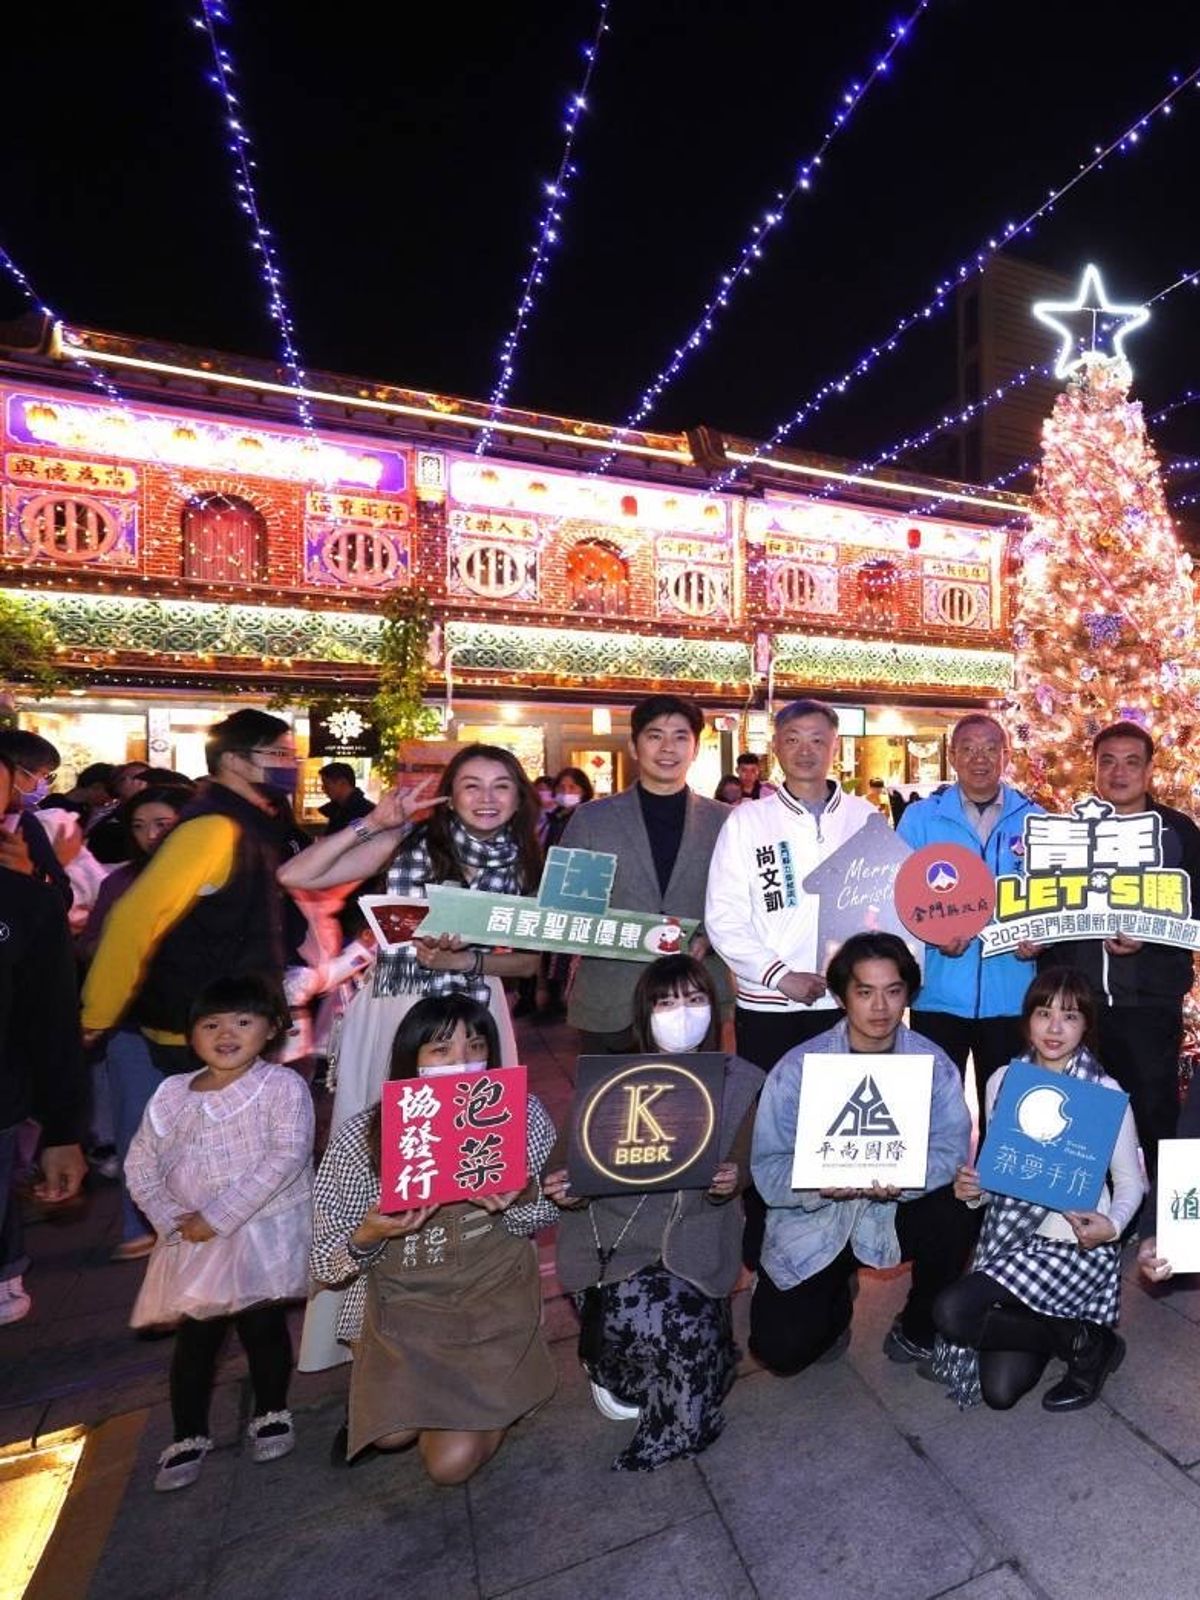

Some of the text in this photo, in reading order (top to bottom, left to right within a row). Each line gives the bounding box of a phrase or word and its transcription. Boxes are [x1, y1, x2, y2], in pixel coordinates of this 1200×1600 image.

[1028, 817, 1156, 870] 青年
[756, 844, 785, 914] 尚文凱
[486, 906, 643, 949] 商家聖誕優惠
[394, 1083, 443, 1202] 協發行
[452, 1075, 514, 1193] 泡菜
[617, 1083, 677, 1145] K
[815, 1140, 907, 1162] 平尚國際
